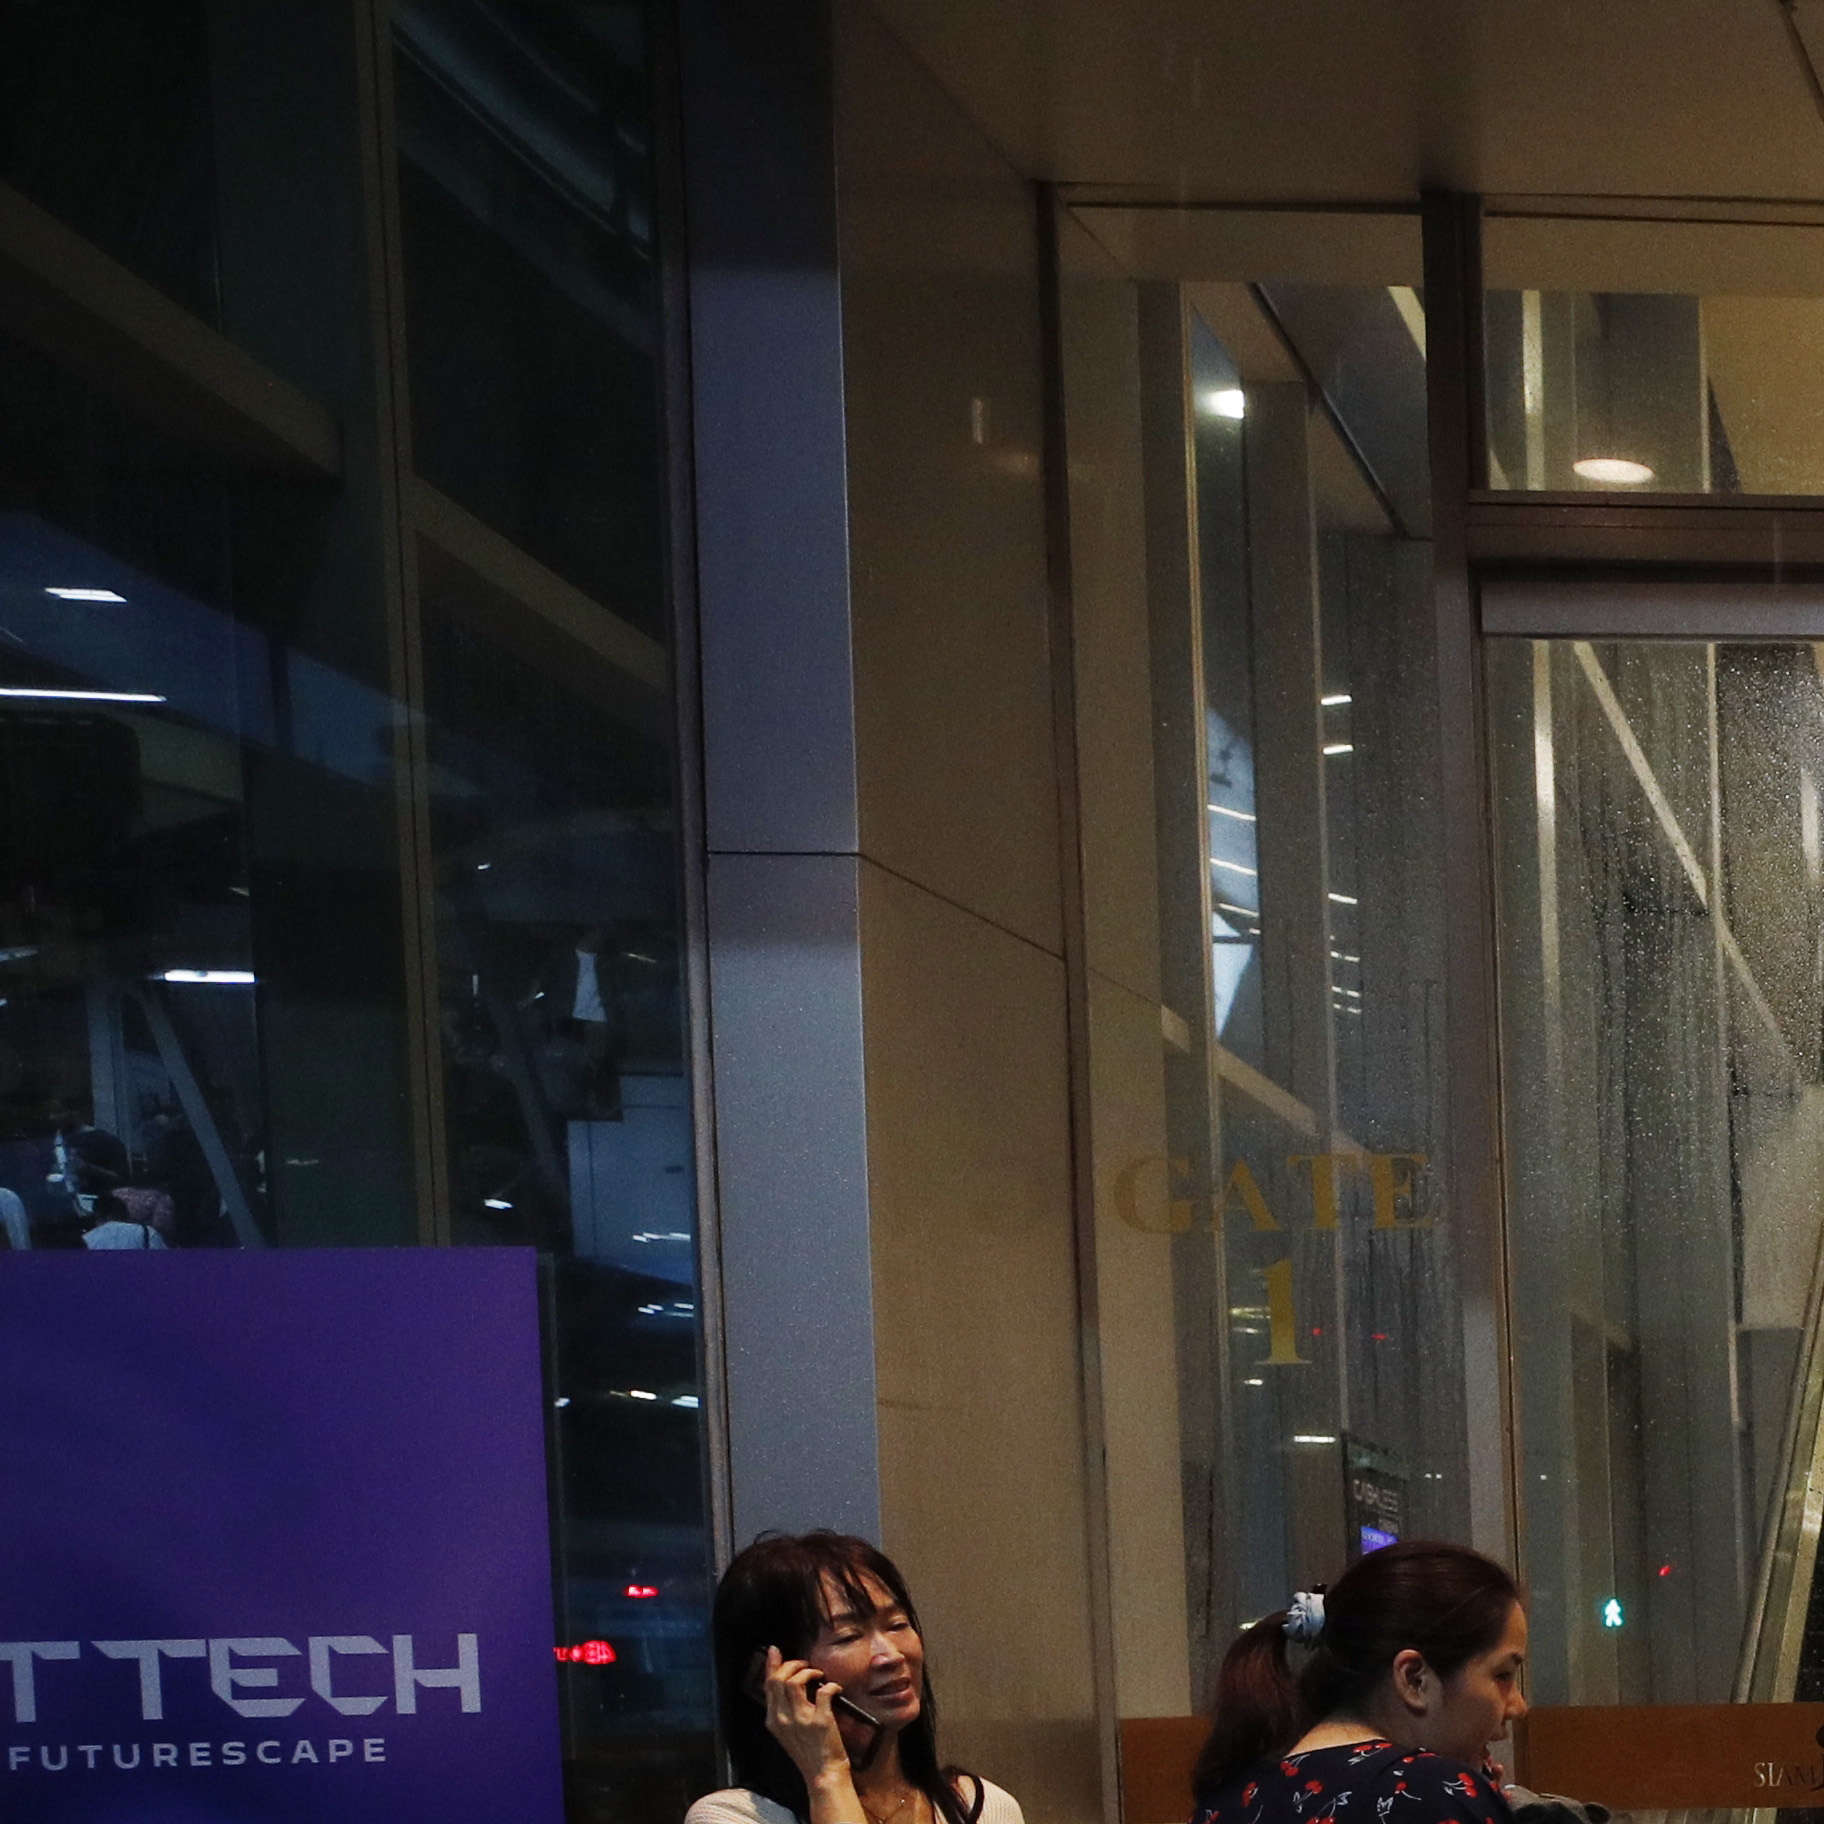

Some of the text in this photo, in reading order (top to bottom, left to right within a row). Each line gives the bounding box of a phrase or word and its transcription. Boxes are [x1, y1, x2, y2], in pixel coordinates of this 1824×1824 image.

[1112, 1152, 1438, 1235] GATE
[1255, 1257, 1312, 1365] 1
[92, 1633, 482, 1720] TECH
[8, 1737, 387, 1771] FUTURESCAPE
